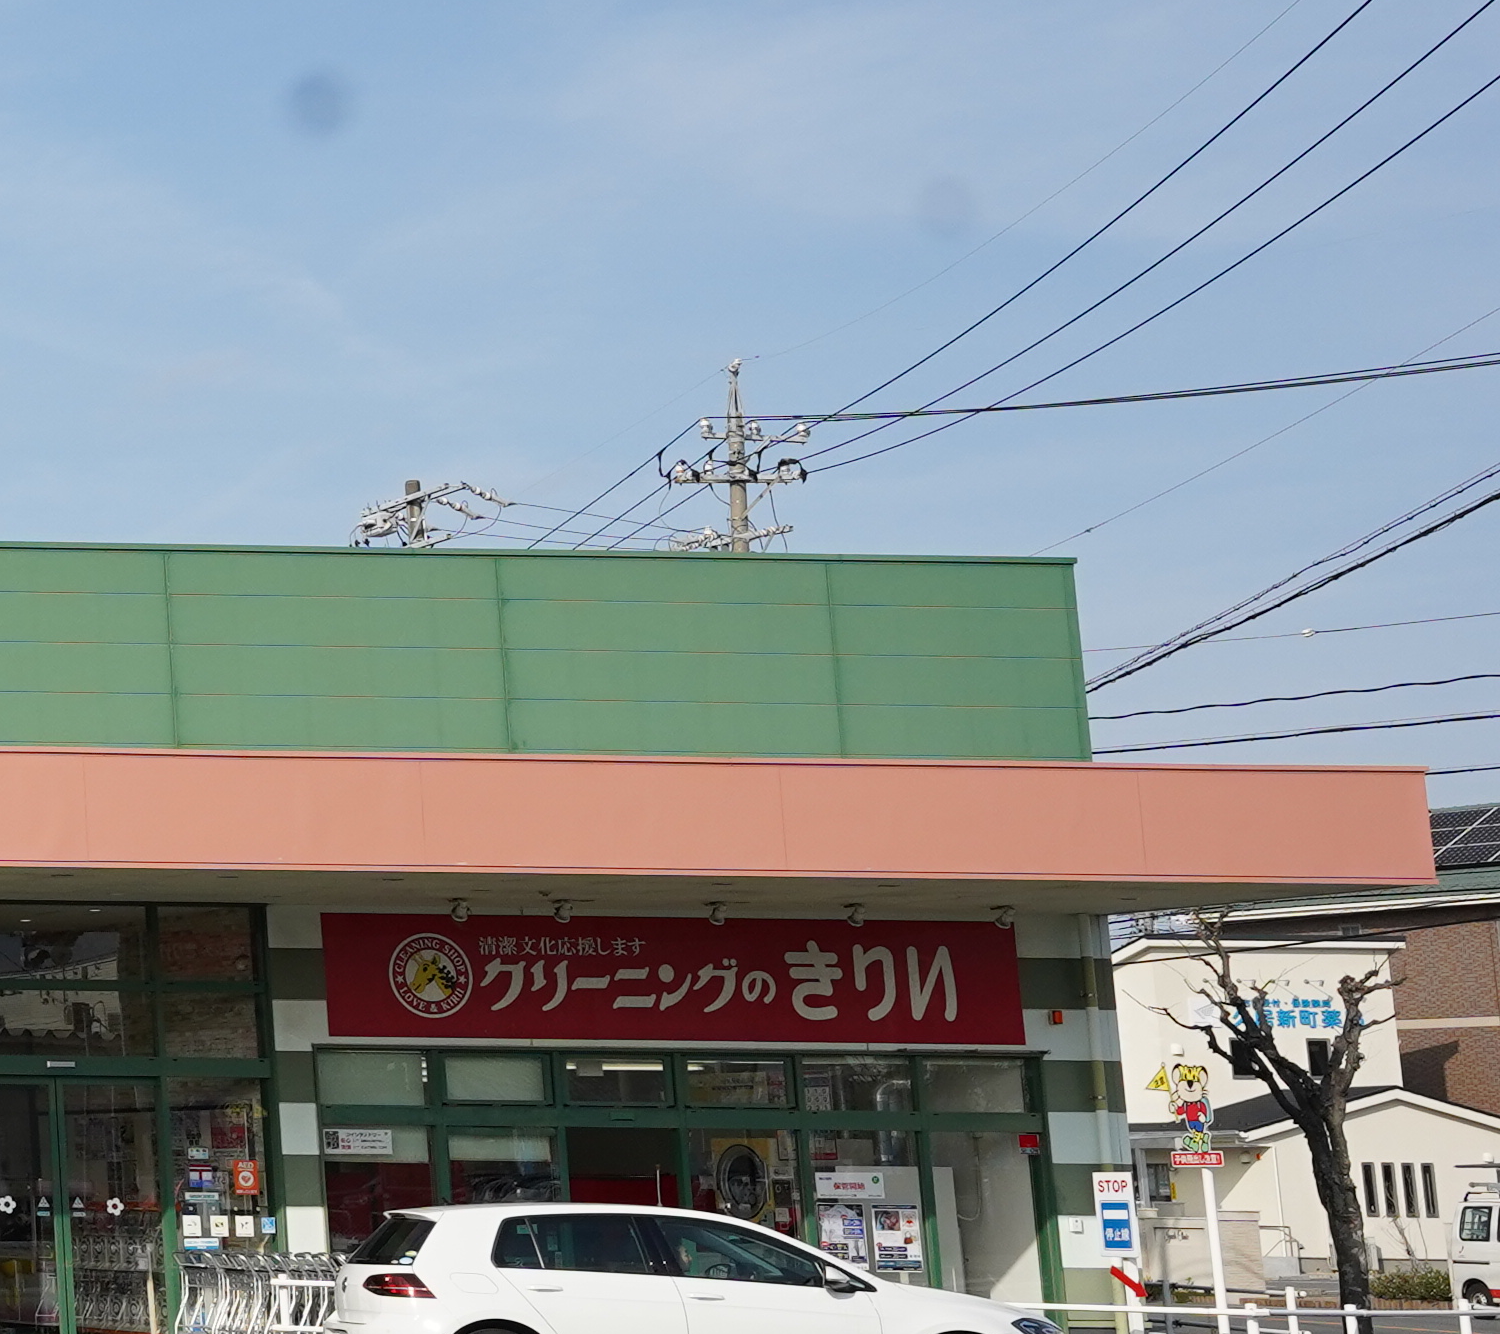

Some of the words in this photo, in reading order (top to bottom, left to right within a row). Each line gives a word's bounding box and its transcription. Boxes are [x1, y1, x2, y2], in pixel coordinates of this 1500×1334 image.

[394, 938, 442, 973] CLEANING
[442, 944, 467, 973] SHOP
[478, 936, 647, 957] 清潔文化応援します
[399, 986, 427, 1012] LOVE
[237, 1161, 255, 1169] AED
[1097, 1179, 1128, 1193] STOP
[1104, 1228, 1131, 1243] 停止線
